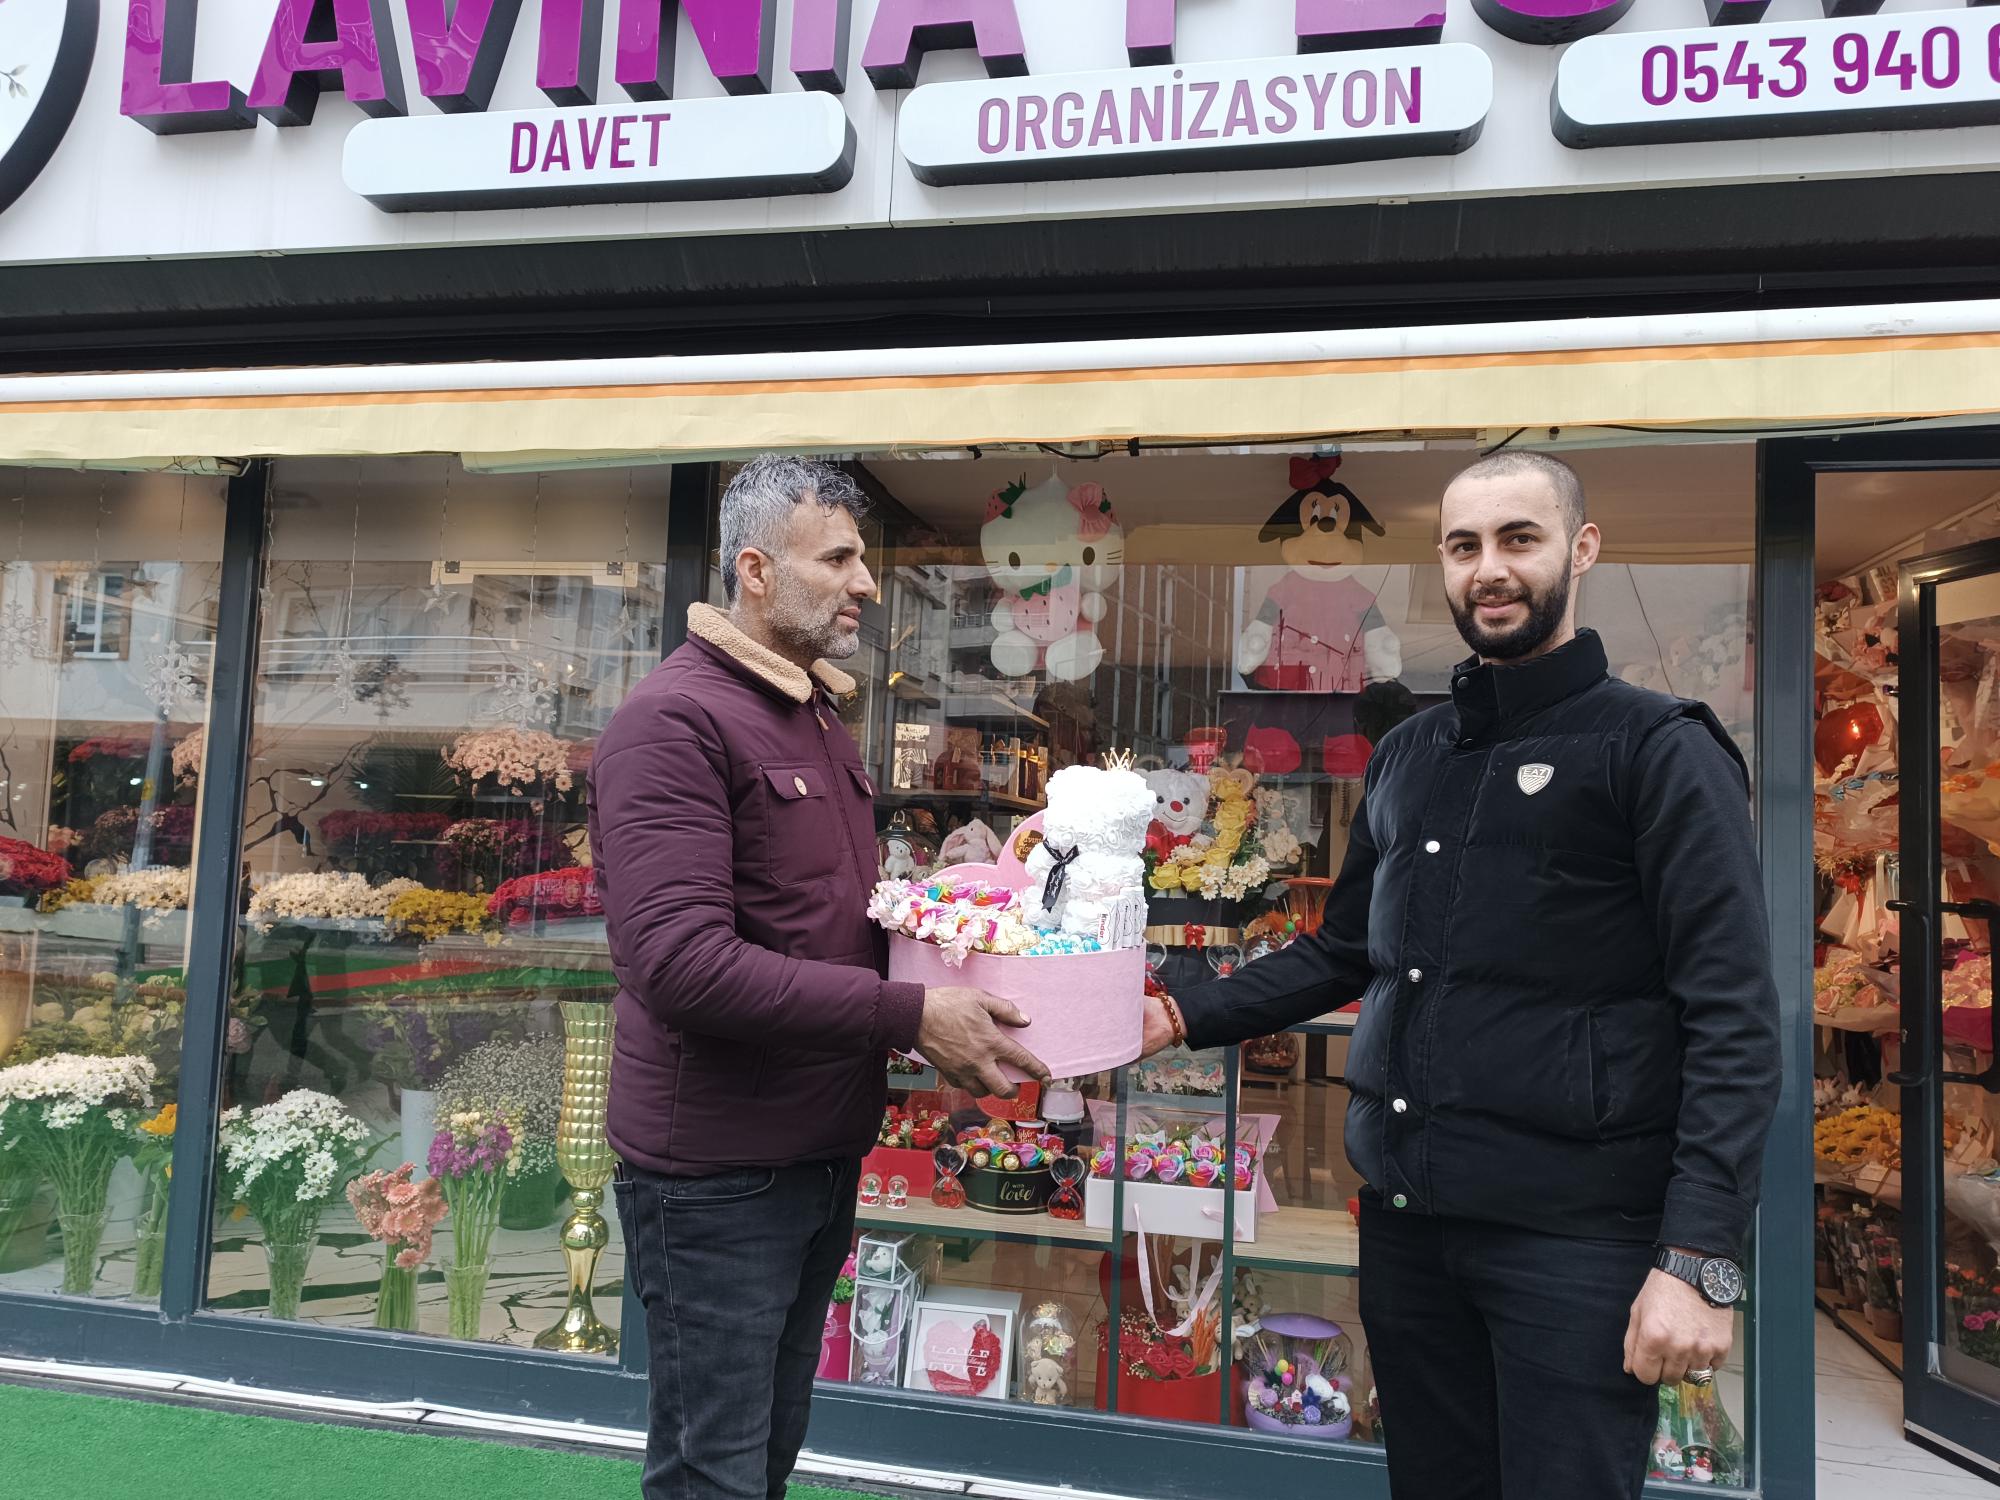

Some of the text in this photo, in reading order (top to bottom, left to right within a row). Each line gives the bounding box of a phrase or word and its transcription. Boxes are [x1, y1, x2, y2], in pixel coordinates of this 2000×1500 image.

[1641, 36, 1808, 107] 0543
[1832, 25, 1961, 95] 940
[509, 113, 671, 174] DAVET
[977, 66, 1422, 155] ORGANİZASYON
[1000, 1180, 1035, 1201] love
